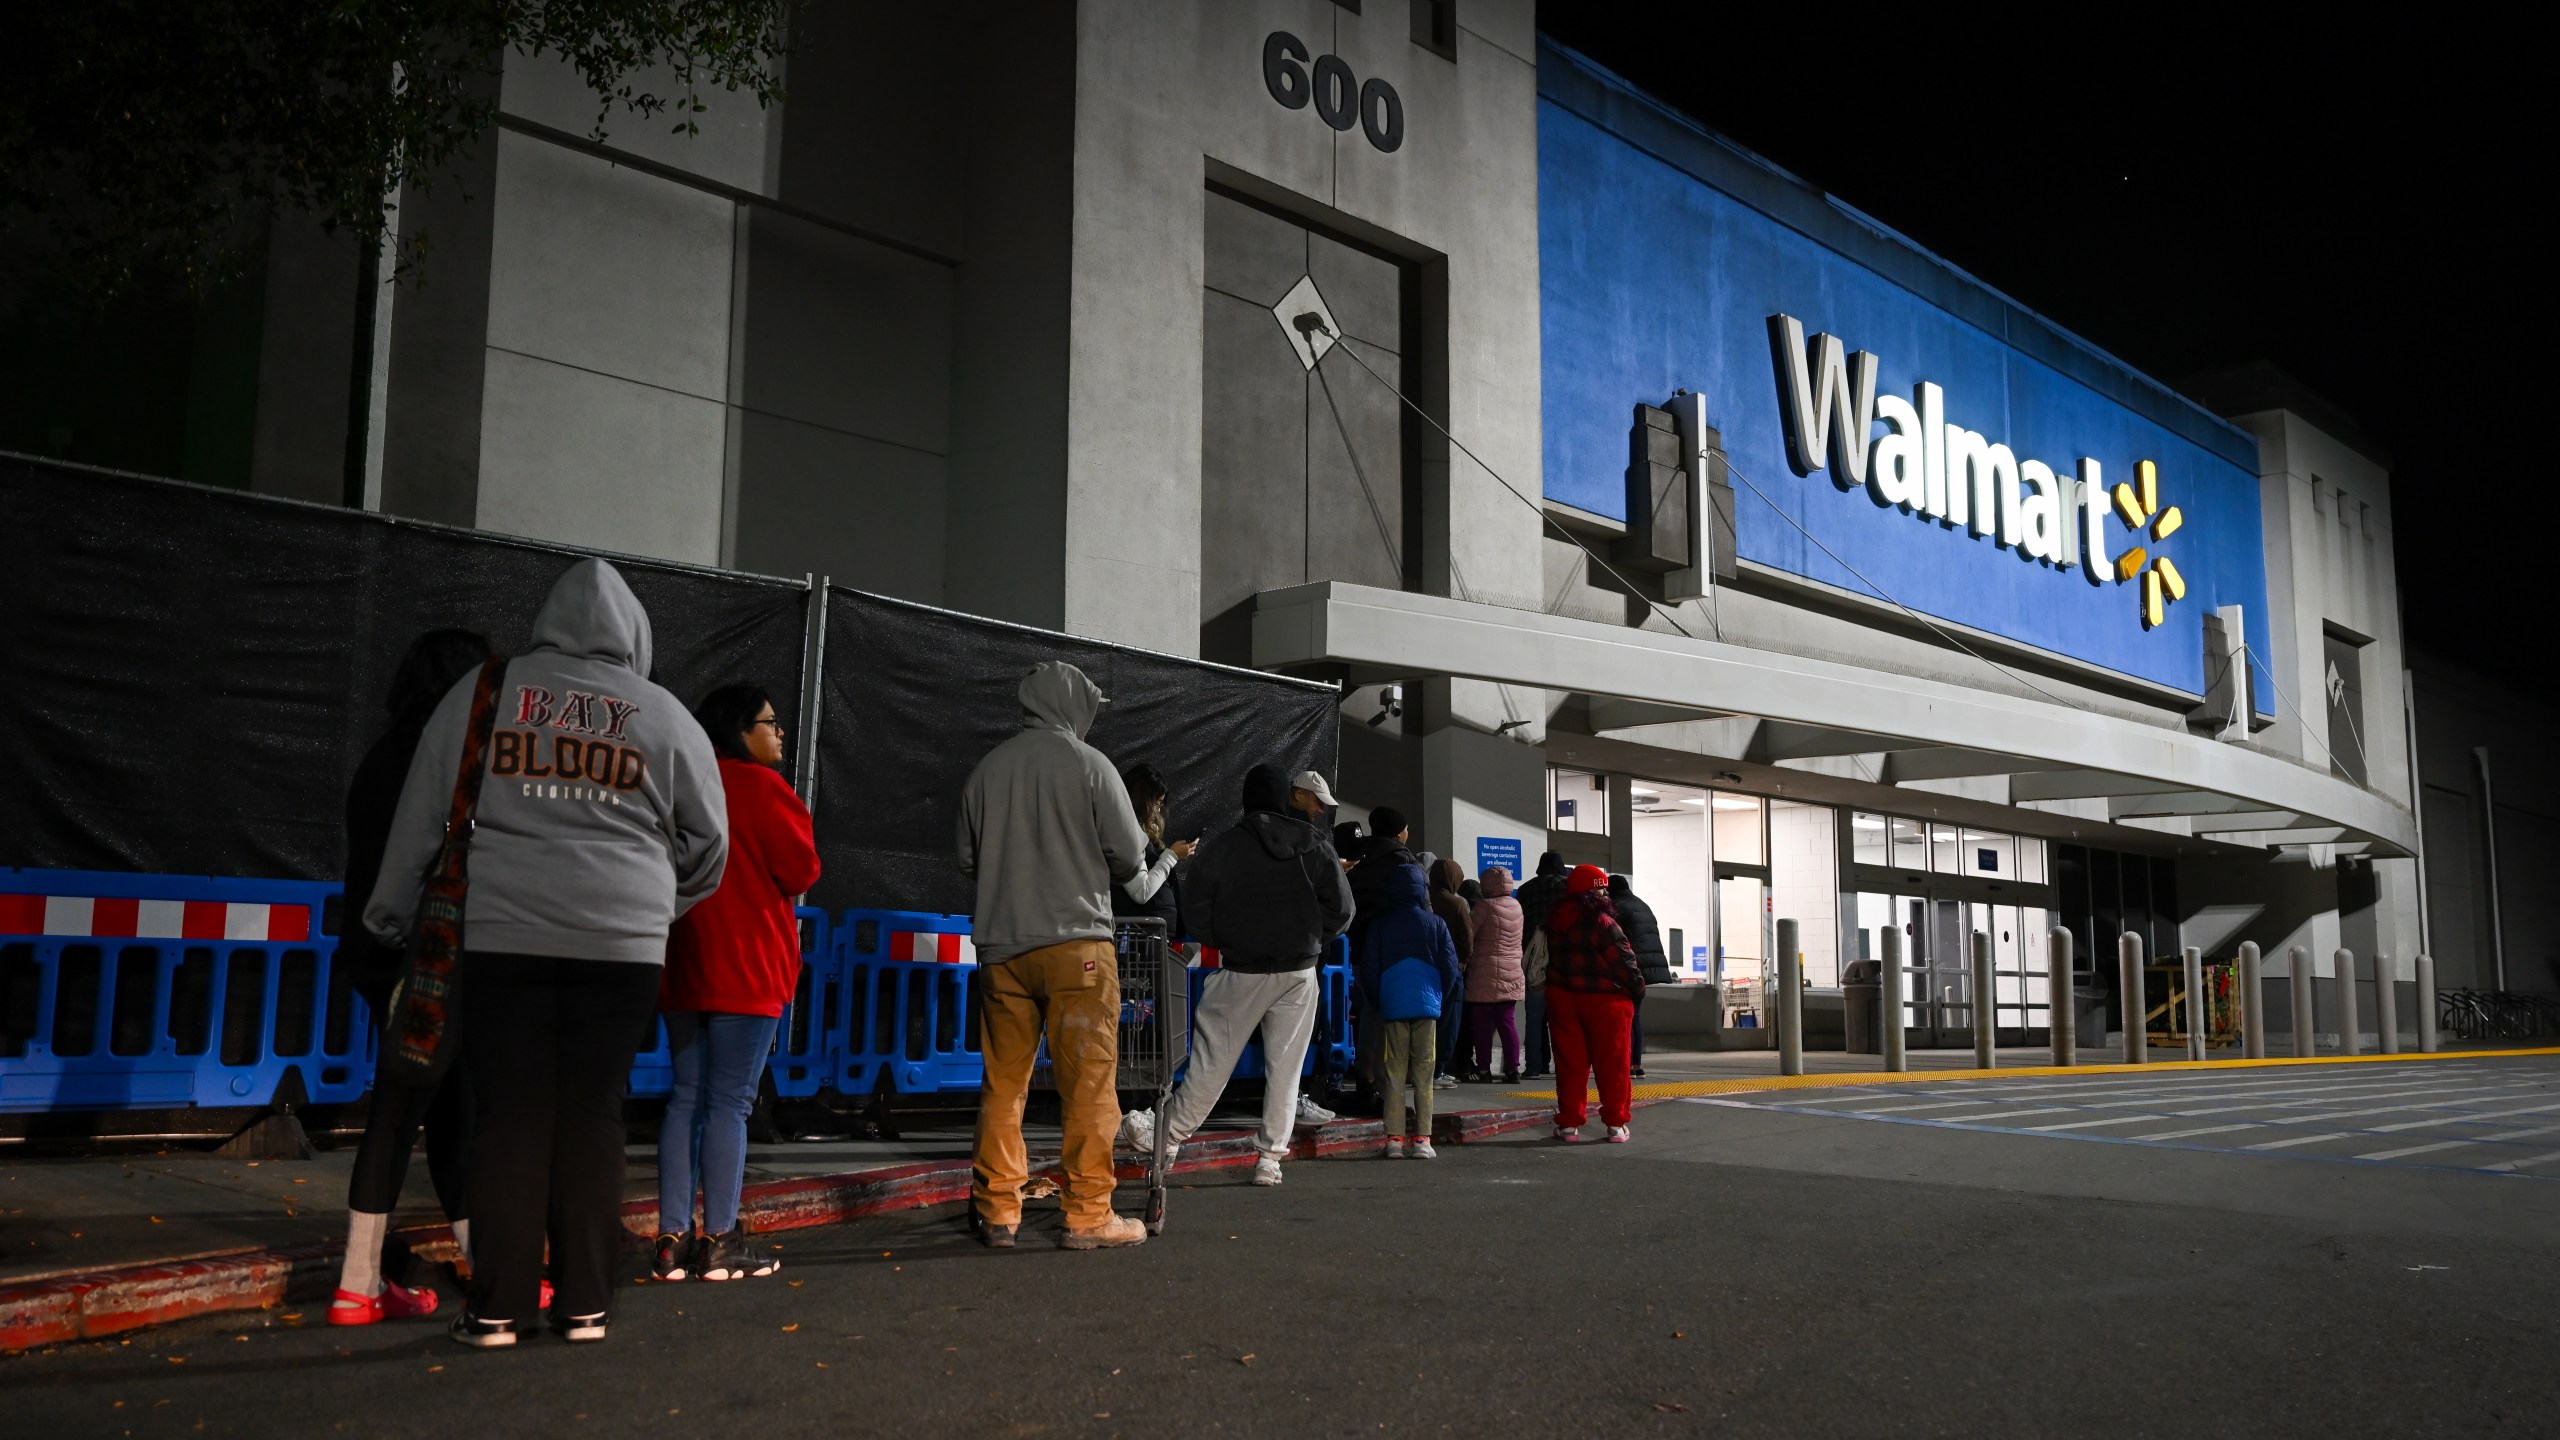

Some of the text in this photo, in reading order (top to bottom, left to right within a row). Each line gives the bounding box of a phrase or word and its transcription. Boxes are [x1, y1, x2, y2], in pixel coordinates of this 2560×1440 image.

[1263, 31, 1404, 153] 600
[1767, 313, 2115, 583] Walmart
[514, 685, 640, 742] BAY
[491, 729, 646, 792] BLOOD
[522, 783, 620, 805] CLOTHING
